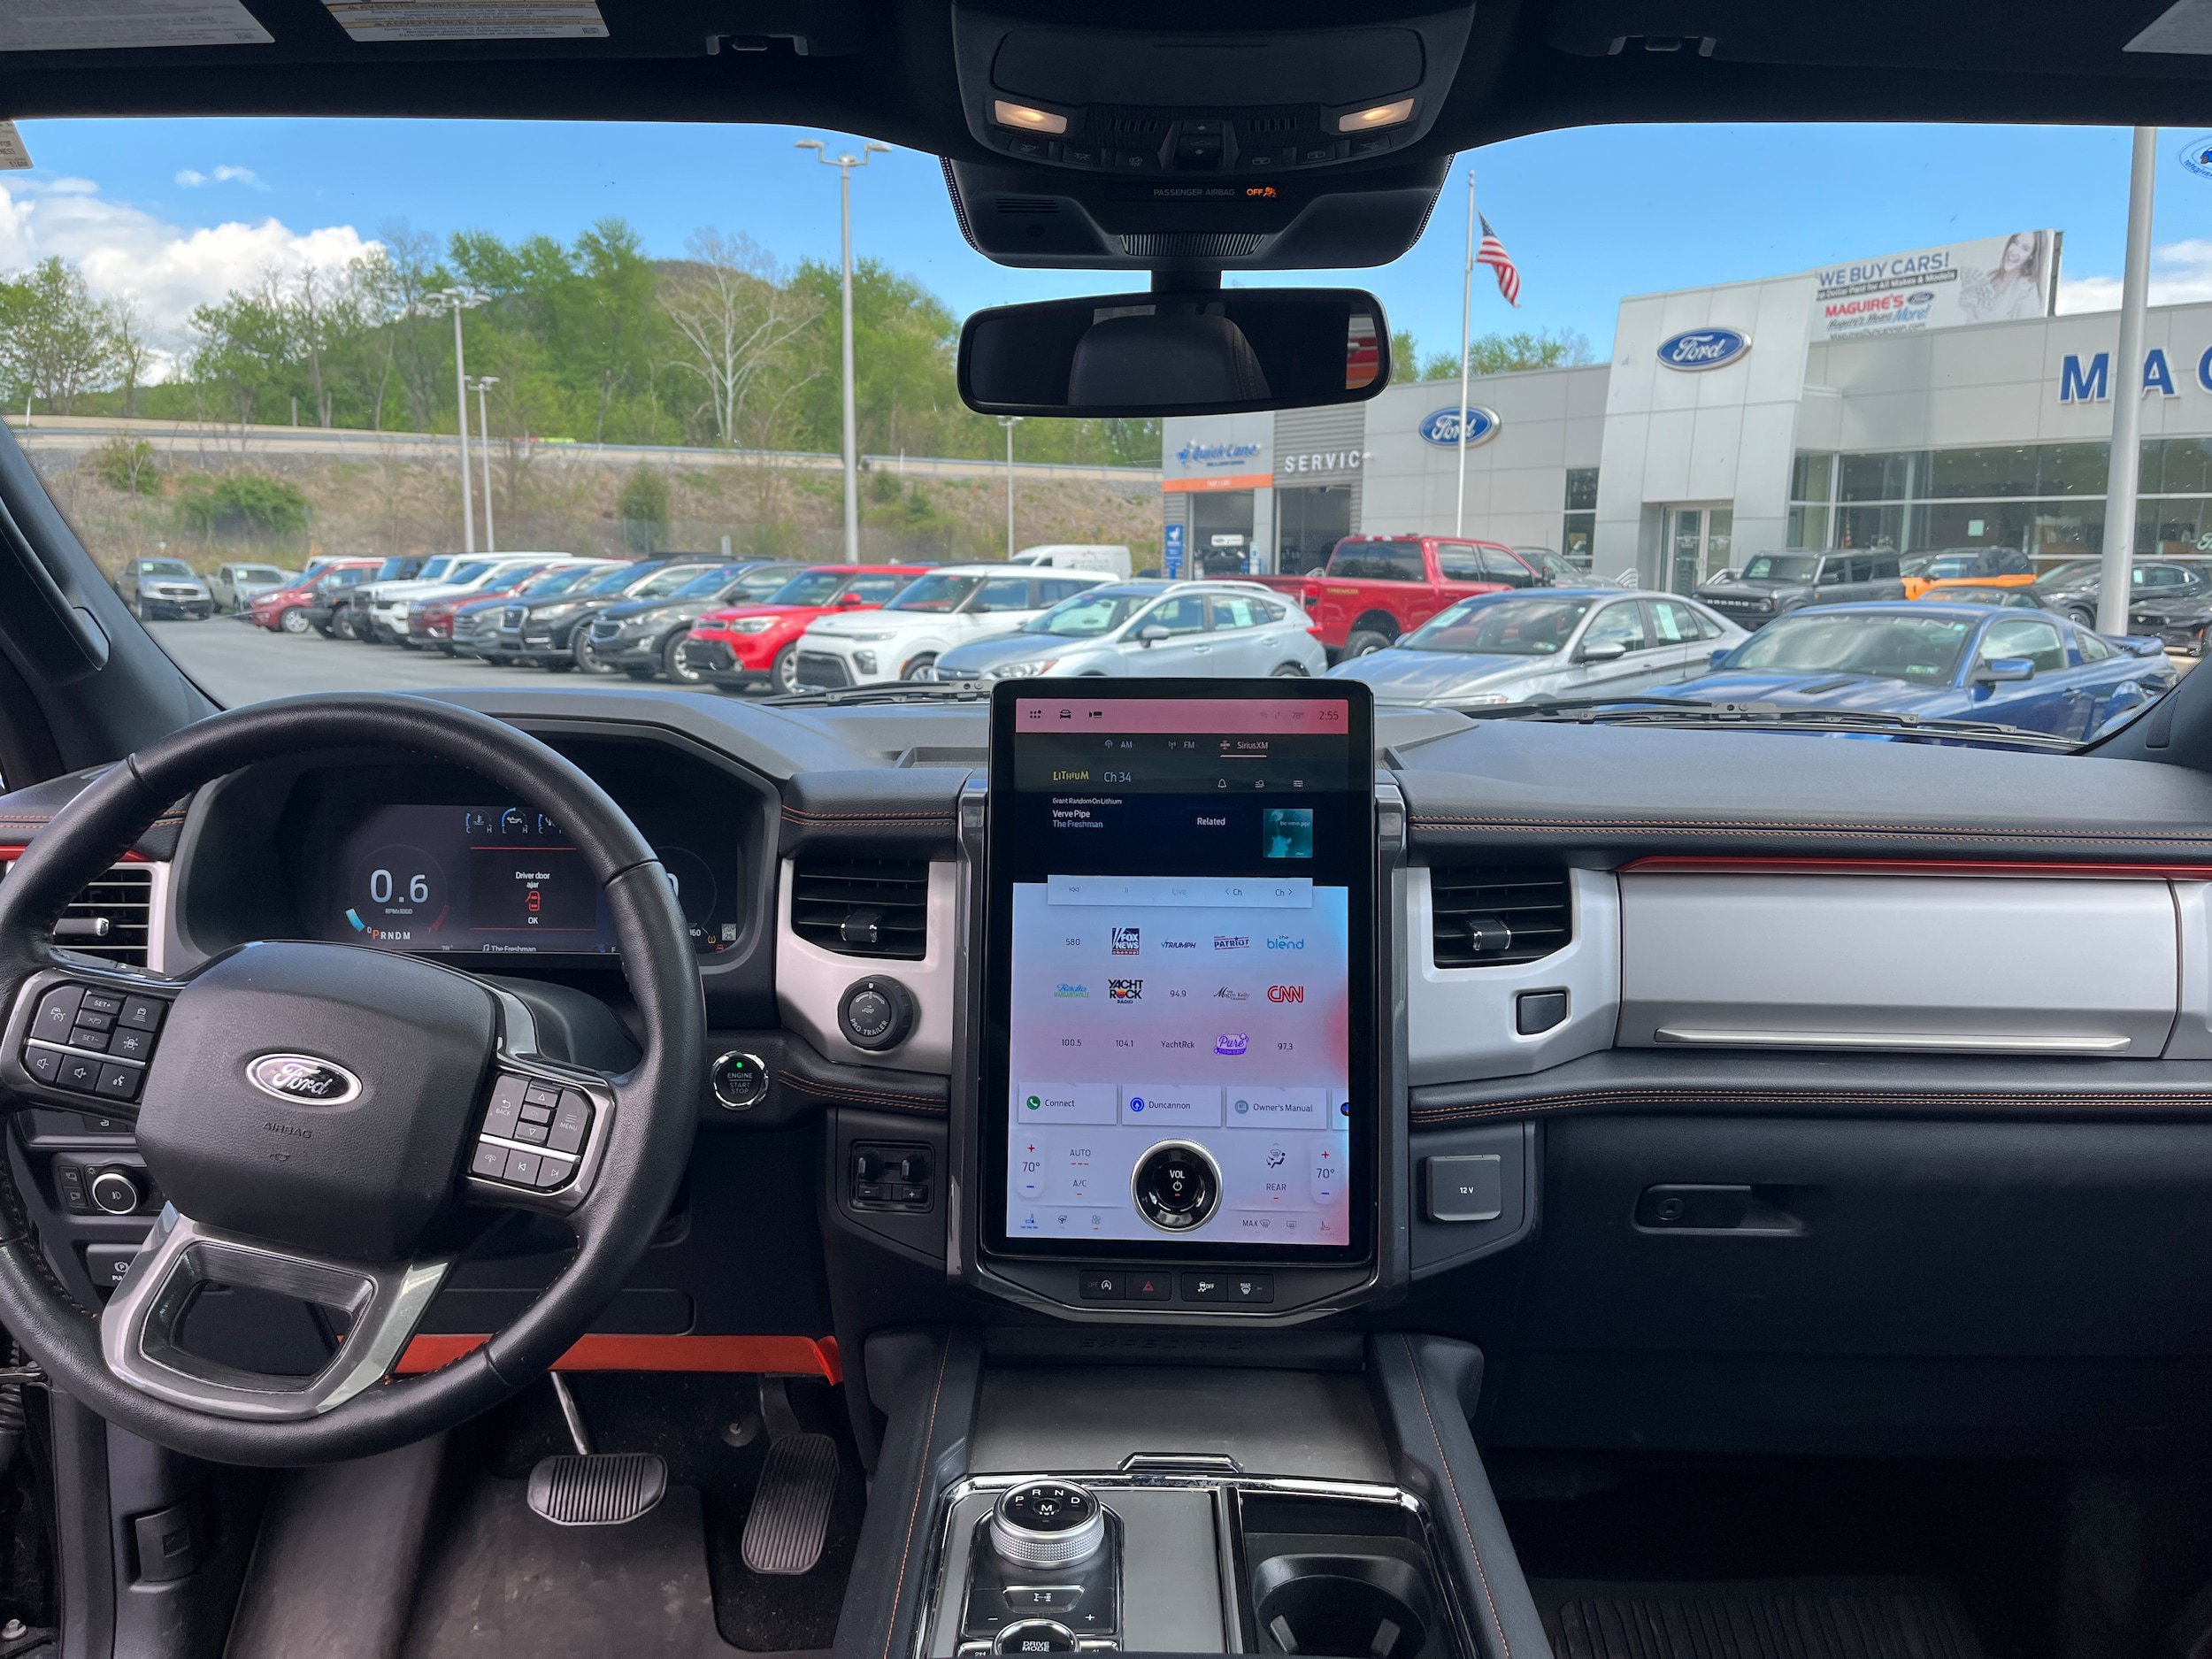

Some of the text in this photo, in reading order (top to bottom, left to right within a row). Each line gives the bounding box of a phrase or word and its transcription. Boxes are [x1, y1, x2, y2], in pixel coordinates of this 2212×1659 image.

[1246, 188, 1263, 196] OFF
[1820, 252, 1949, 287] WE BUY CARS!
[1825, 294, 1904, 318] MAGUIRE'S
[1893, 305, 1931, 322] More!
[1672, 334, 1725, 361] Ford
[1192, 442, 1258, 461] Quick Lane
[1318, 710, 1339, 720] 2:55
[1183, 741, 1195, 749] FM
[1236, 741, 1269, 749] SiriusXM
[1103, 772, 1117, 783] Ch
[1119, 772, 1133, 783] 34
[1052, 810, 1091, 819] Verve Pipe
[1197, 817, 1226, 826] Related
[370, 869, 429, 903] 0.6
[1214, 939, 1249, 949] PATRIOT
[1266, 939, 1304, 949] blend
[1108, 979, 1144, 989] YACHT
[1110, 989, 1142, 999] ROCK
[1267, 986, 1304, 1003] CNN
[849, 1018, 888, 1036] PRO TRAILER
[1218, 1036, 1245, 1048] Pure
[272, 1062, 332, 1097] Ford
[1148, 1101, 1191, 1110] Duncannon
[262, 1121, 312, 1140] AIRBAG
[559, 1122, 578, 1132] MENU
[1022, 1162, 1041, 1172] 70°
[1169, 1170, 1185, 1179] VOL
[1316, 1168, 1335, 1179] 70°
[1015, 1495, 1025, 1504] P
